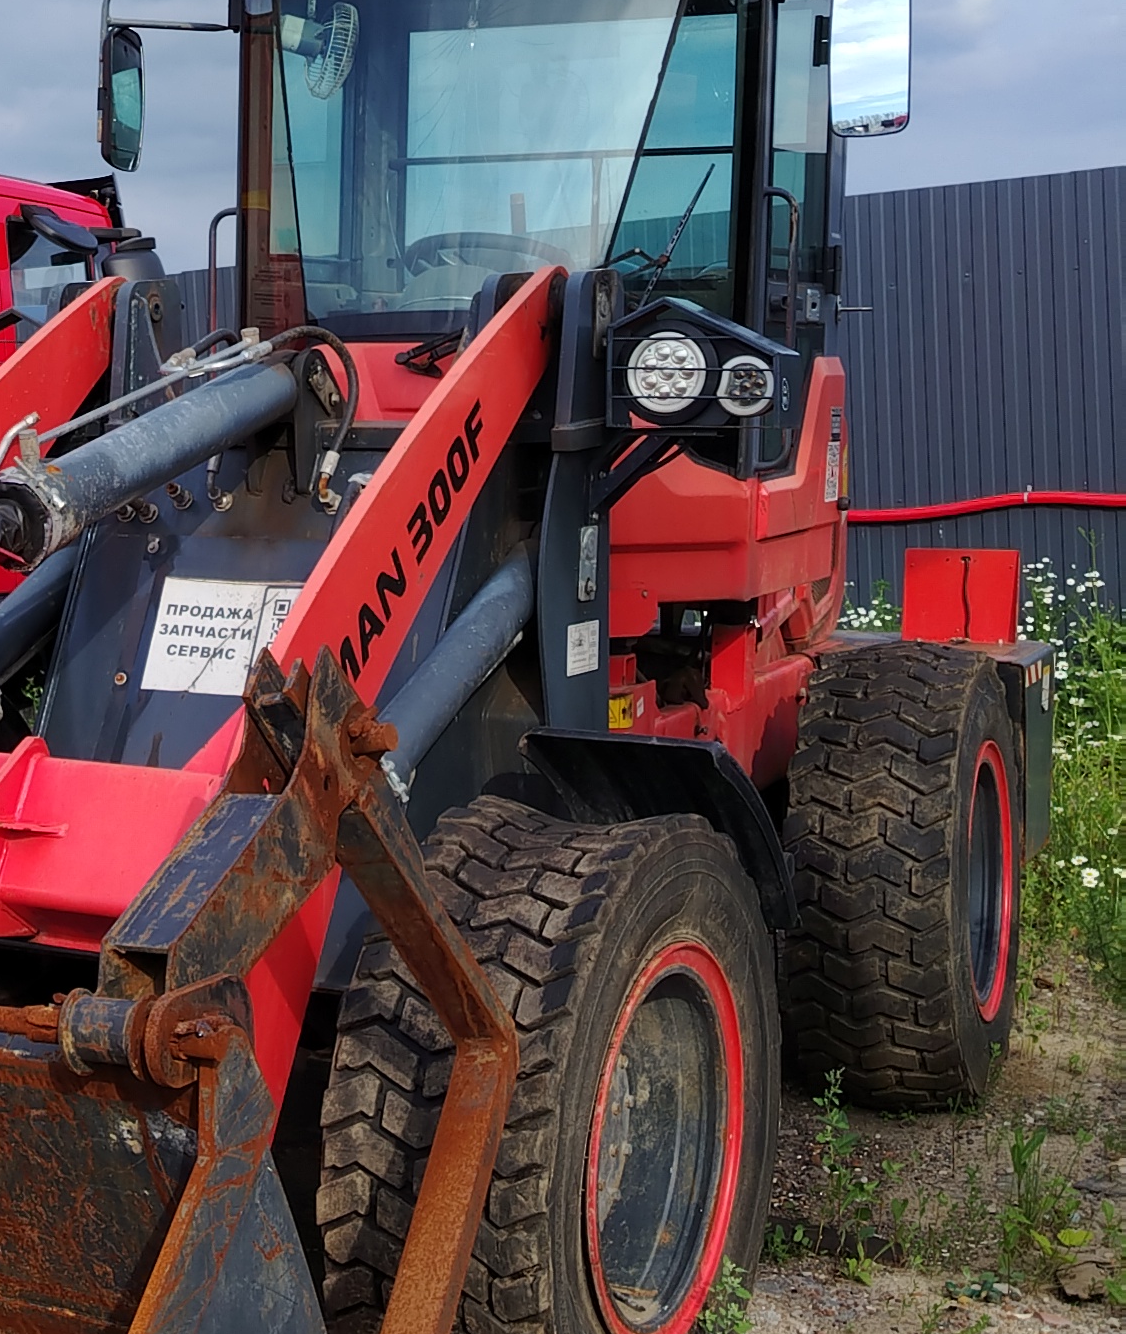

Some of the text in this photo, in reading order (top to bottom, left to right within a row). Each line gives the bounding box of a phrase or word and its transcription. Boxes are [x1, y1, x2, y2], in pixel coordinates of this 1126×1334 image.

[406, 398, 484, 566] 300F
[165, 603, 254, 621] ПРОДАЖА
[158, 623, 253, 641] ЗАПЧАСТИ
[166, 643, 237, 661] СЕРВИС
